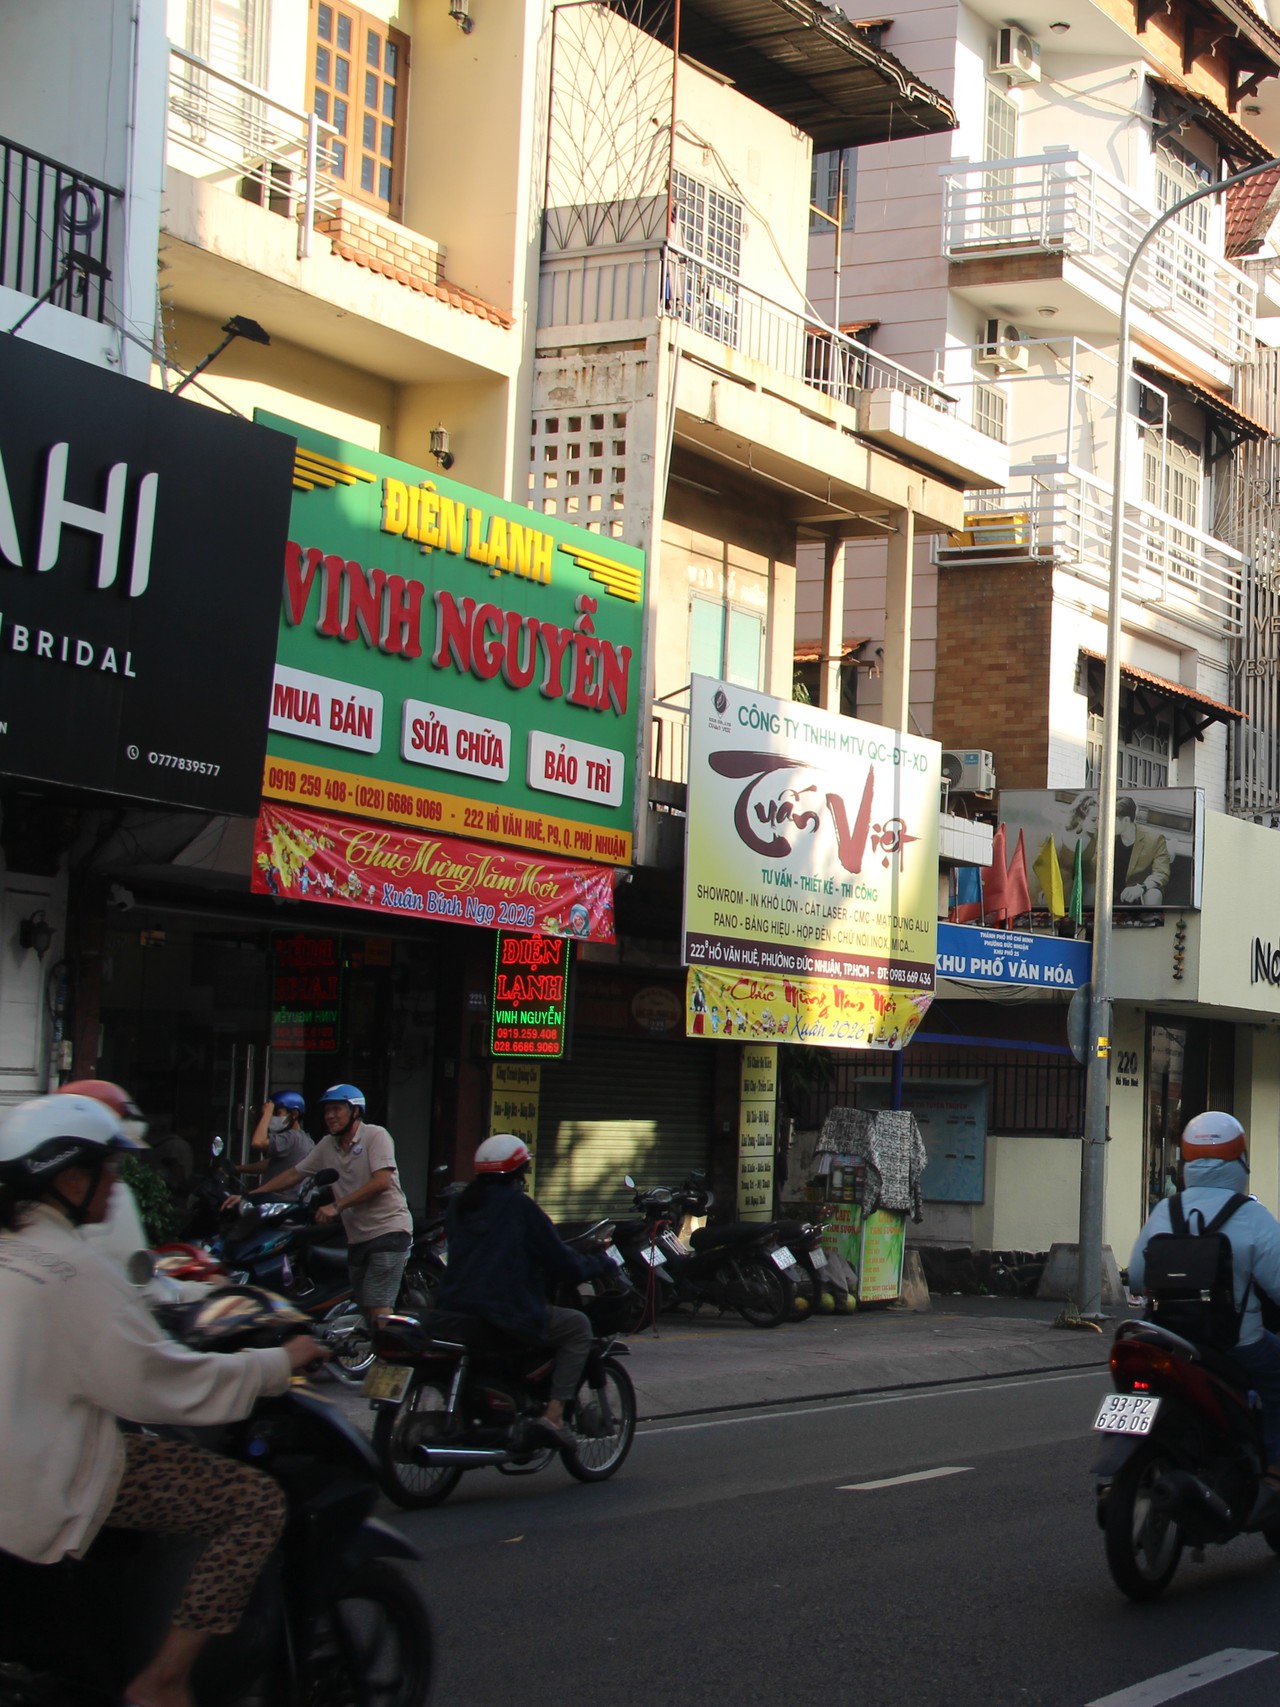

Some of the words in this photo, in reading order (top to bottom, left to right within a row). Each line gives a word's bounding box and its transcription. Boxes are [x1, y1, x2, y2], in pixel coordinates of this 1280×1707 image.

[381, 477, 465, 555] ĐIỆN
[466, 507, 554, 585] LẠNH
[283, 540, 425, 659] VINH
[432, 593, 633, 716] NGUYỄN
[12, 624, 137, 678] BRIDAL
[1230, 658, 1278, 678] VEST
[273, 683, 322, 727] MUA
[330, 696, 374, 740] BÁN
[411, 711, 449, 756] SỬA
[456, 728, 504, 769] CHỮA
[738, 703, 781, 735] CÔNG
[784, 717, 800, 738] TY
[803, 723, 837, 750] TNHH
[840, 733, 866, 756] MTV
[868, 742, 928, 773] QC-ĐT-XD
[148, 751, 221, 777] 0777839577
[544, 743, 578, 785] BẢO
[586, 758, 612, 793] TRÌ
[269, 767, 296, 792] 0919
[300, 773, 322, 797] 259
[325, 779, 347, 802] 408
[355, 785, 385, 811] (028)
[387, 792, 413, 815] 6686
[416, 796, 442, 821] 9069
[464, 808, 484, 829] 222
[487, 806, 500, 832] HỒ
[502, 814, 522, 838] VĂN
[563, 828, 572, 849] Q.
[595, 835, 626, 860] NHUẬN
[708, 750, 824, 859] Tuấn
[826, 763, 924, 875] Việt
[339, 828, 411, 869] Chúc
[397, 837, 476, 894] Mừng
[465, 852, 518, 889] Năm
[506, 862, 563, 899] Mới
[761, 868, 774, 885] TƯ
[774, 867, 792, 888] VẤN
[800, 874, 822, 893] THIẾT
[823, 876, 835, 895] KẾ
[841, 883, 853, 898] THI
[855, 883, 878, 902] CÔNG
[381, 882, 425, 911] Xuân
[465, 898, 496, 924] Ngọ
[498, 901, 536, 928] 2026
[697, 884, 744, 905] SHOWROM
[750, 893, 759, 908] IN
[822, 904, 848, 921] LASER
[915, 920, 930, 933] ALU
[713, 912, 738, 929] PANO
[502, 933, 562, 971] ĐIỆN
[723, 945, 741, 962] VĂN
[761, 951, 795, 969] PHƯỜNG
[797, 955, 814, 972] ĐỨC
[889, 968, 906, 983] 0983
[936, 953, 966, 974] KHU
[970, 956, 1004, 977] PHỐ
[1008, 959, 1040, 981] VĂN
[1043, 963, 1075, 985] HÓA
[496, 974, 563, 1007] LẠNH
[496, 1010, 518, 1025] VINH
[520, 1006, 562, 1025] NGUYỄN
[497, 1028, 557, 1040] 0919.259.408
[790, 1013, 827, 1041] Xuân
[829, 1020, 866, 1041] 2026
[494, 1041, 559, 1054] 028.6686.9069
[1117, 1052, 1138, 1074] 220
[1097, 1413, 1150, 1431] 626.06
[1110, 1397, 1152, 1414] 93-P2
